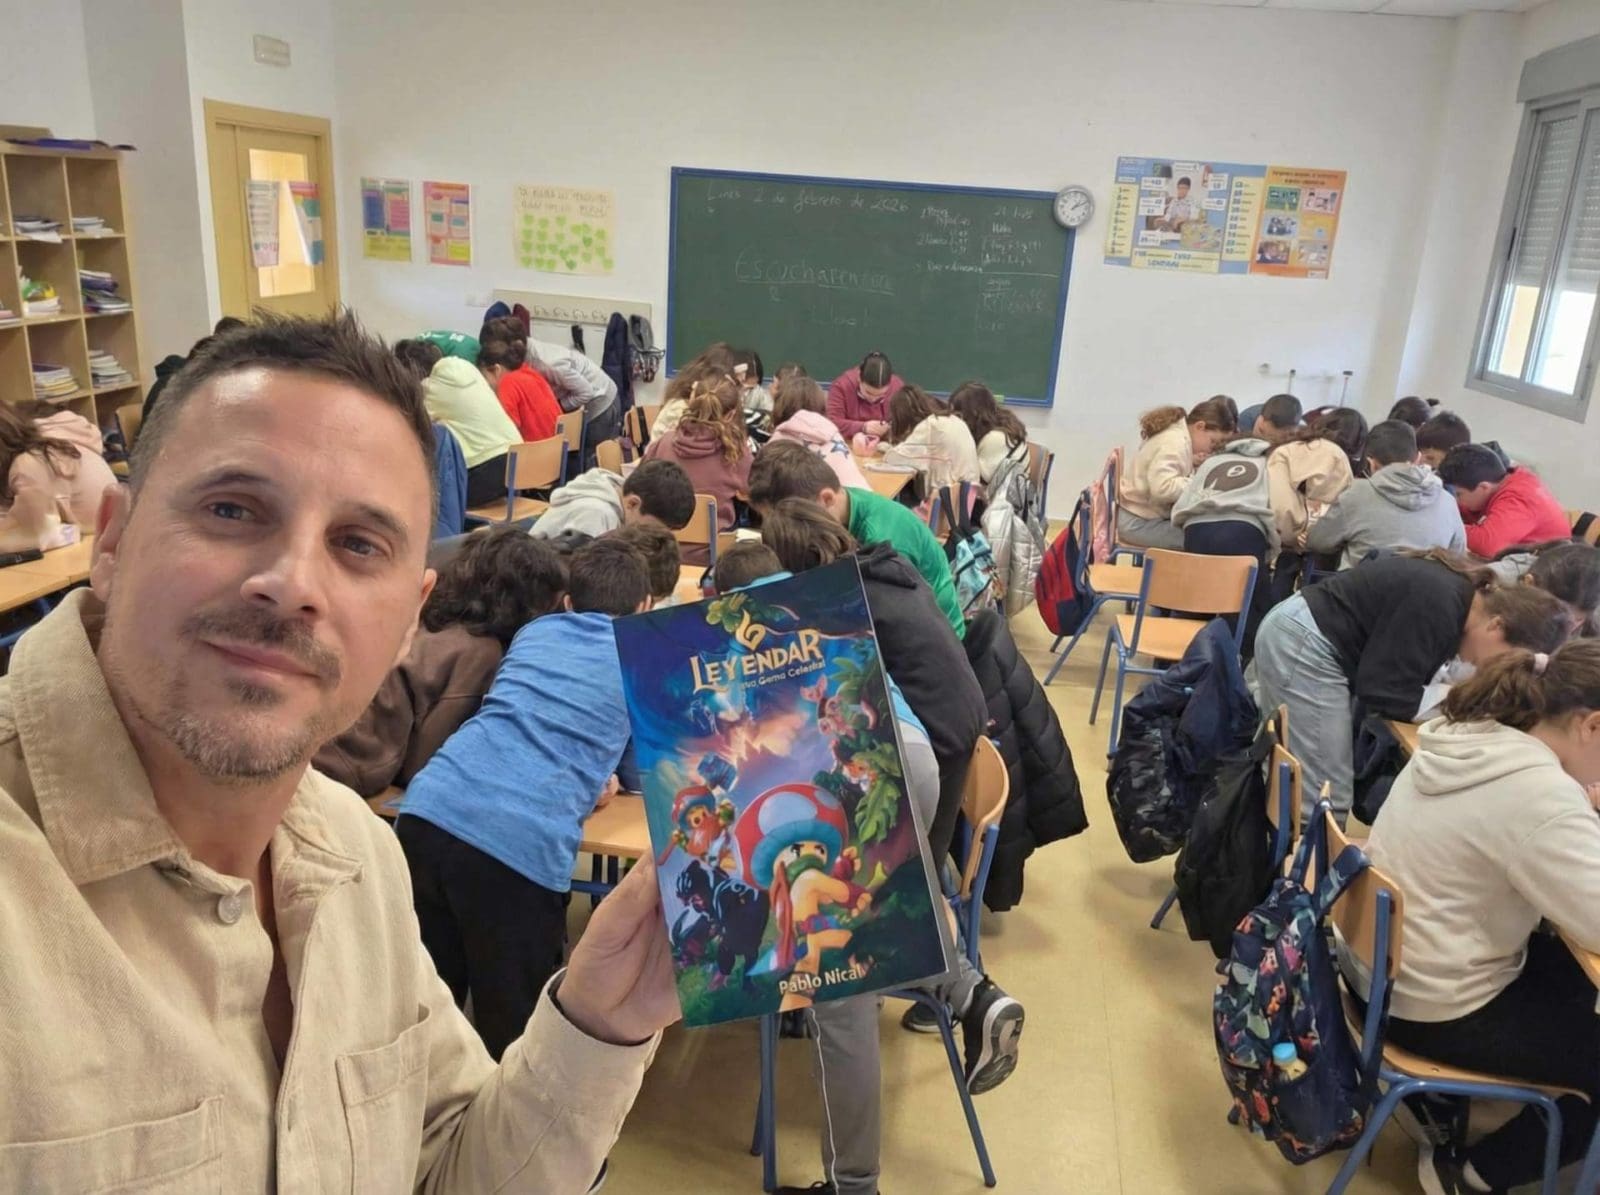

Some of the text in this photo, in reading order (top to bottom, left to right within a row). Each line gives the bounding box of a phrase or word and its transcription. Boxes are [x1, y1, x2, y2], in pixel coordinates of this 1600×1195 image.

[793, 185, 841, 214] febrero
[850, 192, 865, 209] de
[870, 198, 910, 213] 2026
[689, 628, 823, 695] LEYENDAR
[758, 673, 786, 686] Gema
[787, 658, 826, 678] Celestial
[778, 973, 822, 995] Pablo
